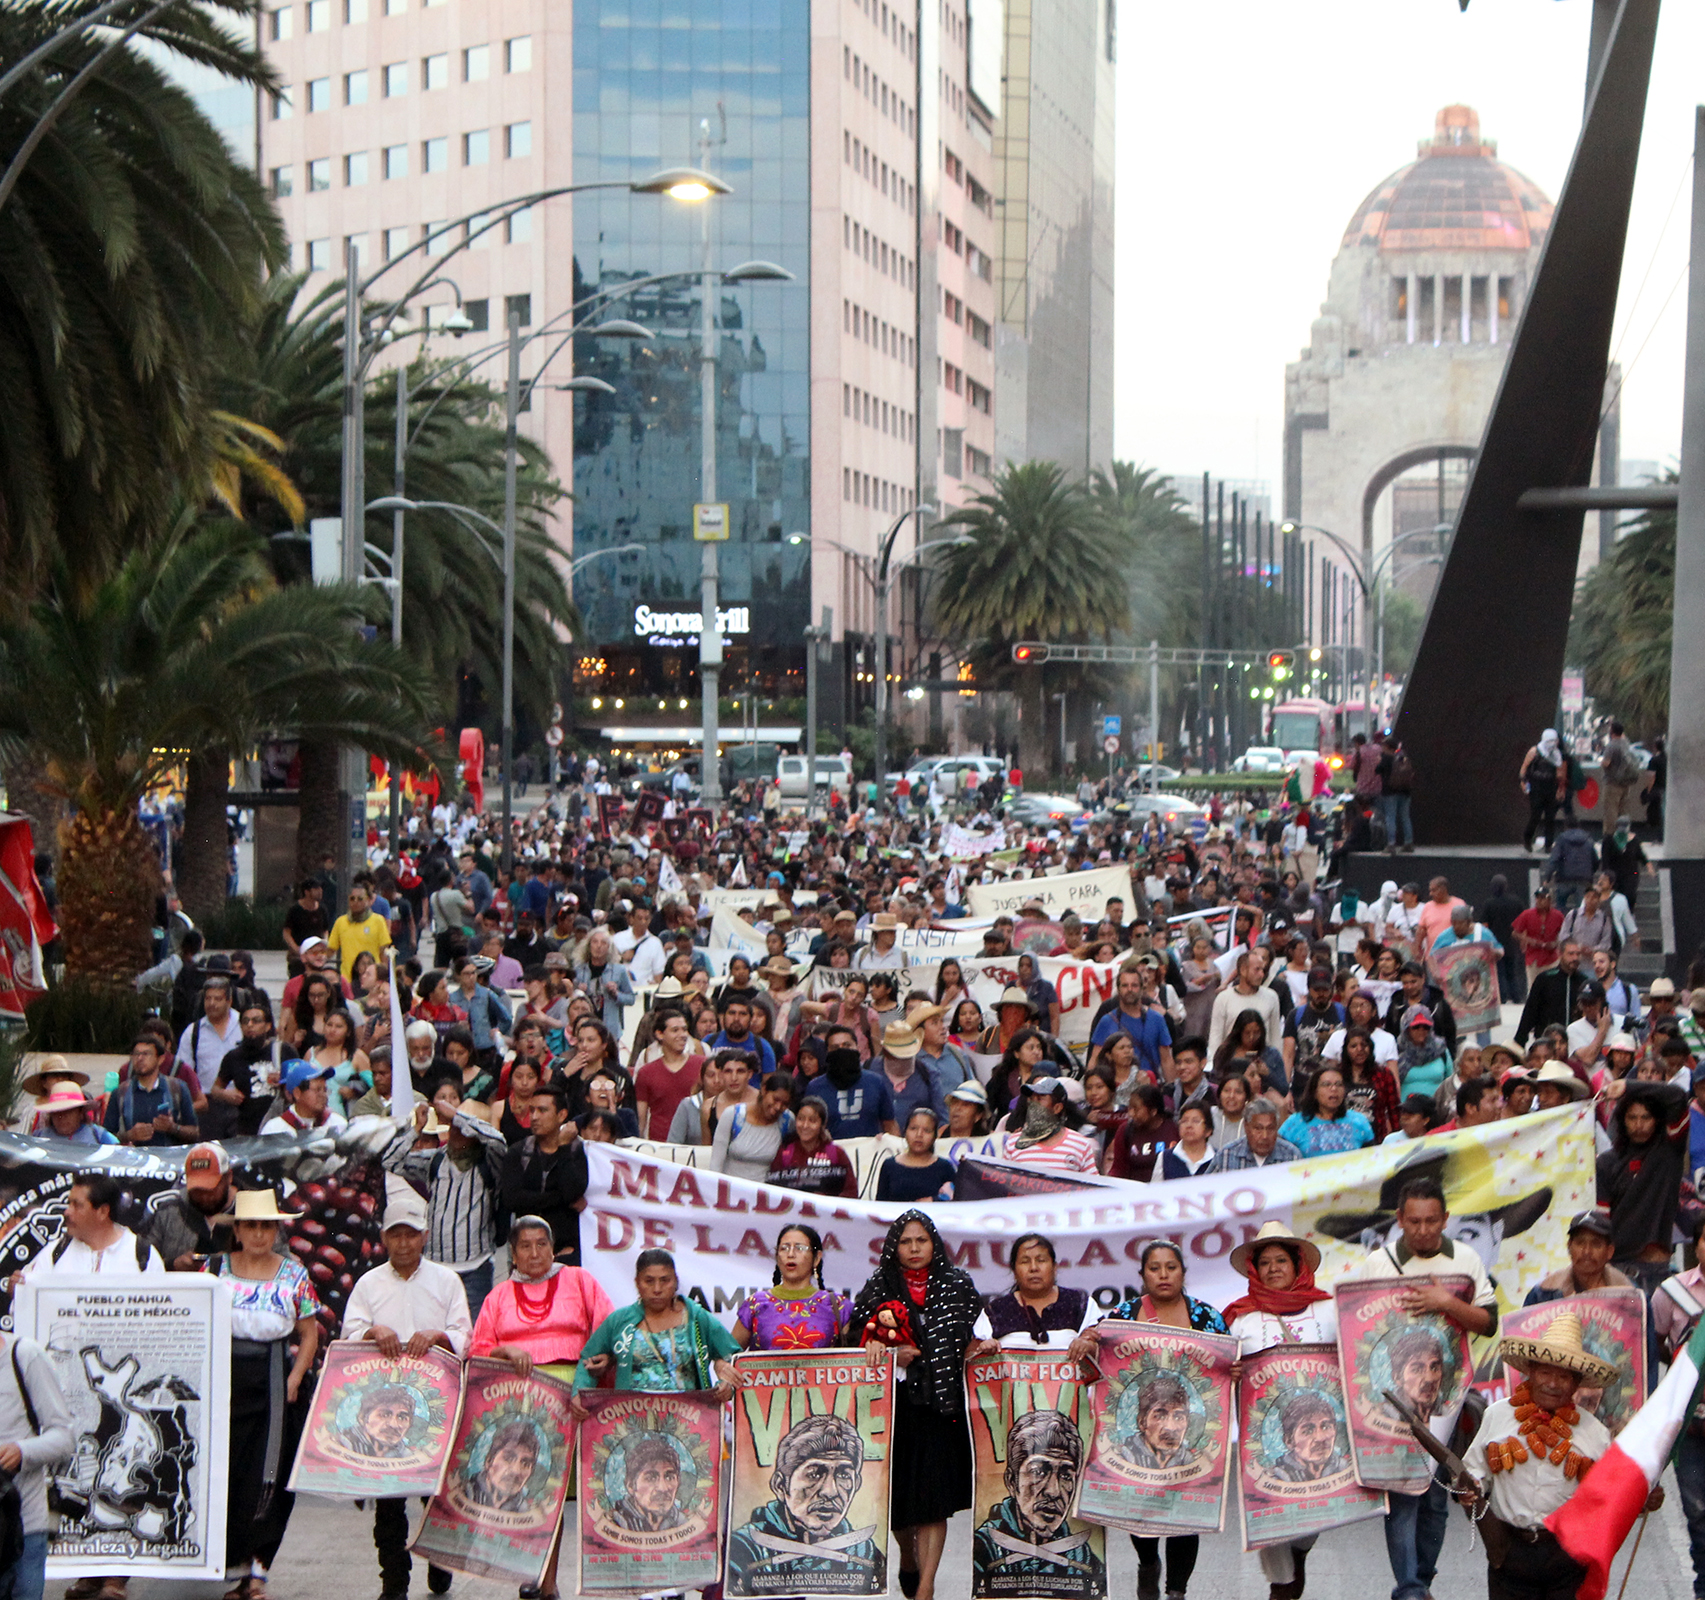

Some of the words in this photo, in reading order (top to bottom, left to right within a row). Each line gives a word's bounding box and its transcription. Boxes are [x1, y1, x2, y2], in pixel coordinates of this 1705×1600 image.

[634, 604, 704, 636] Sonora
[714, 606, 750, 633] rill
[1069, 884, 1103, 901] PARA
[981, 1171, 1007, 1184] LOS
[1010, 1174, 1073, 1194] PARTIDOS
[0, 1187, 38, 1226] unca
[38, 1172, 74, 1195] más
[593, 1210, 676, 1253] DE
[691, 1223, 777, 1259] LA
[77, 1295, 124, 1305] PUEBLO
[127, 1295, 173, 1304] NAHUA
[57, 1308, 80, 1318] DEL
[84, 1308, 121, 1318] VALLE
[125, 1308, 140, 1318] DE
[143, 1305, 191, 1318] MÉXICO
[1113, 1336, 1216, 1369] CONVOCATORIA
[343, 1357, 446, 1382] CONVOCATORIA
[742, 1369, 809, 1388] SAMIR
[815, 1366, 887, 1385] FLORES
[974, 1363, 1032, 1383] SAMIR
[596, 1397, 702, 1426] CONVOCATORIA
[1107, 1457, 1125, 1472] SAMIR
[1125, 1467, 1148, 1479] SOMOS
[1150, 1472, 1172, 1481] TODAS
[1180, 1466, 1202, 1479] TODOS
[1262, 1481, 1282, 1493] SAMIR
[1283, 1485, 1307, 1494] SOMOS
[1308, 1481, 1331, 1493] TODAS
[59, 1516, 88, 1536] ida,
[601, 1525, 620, 1540] SAMIR
[620, 1534, 643, 1545] SOMOS
[645, 1535, 668, 1545] TODAS
[675, 1525, 697, 1539] TODOS
[130, 1544, 140, 1560] y
[141, 1539, 200, 1560] Legado
[870, 1582, 879, 1590] 19
